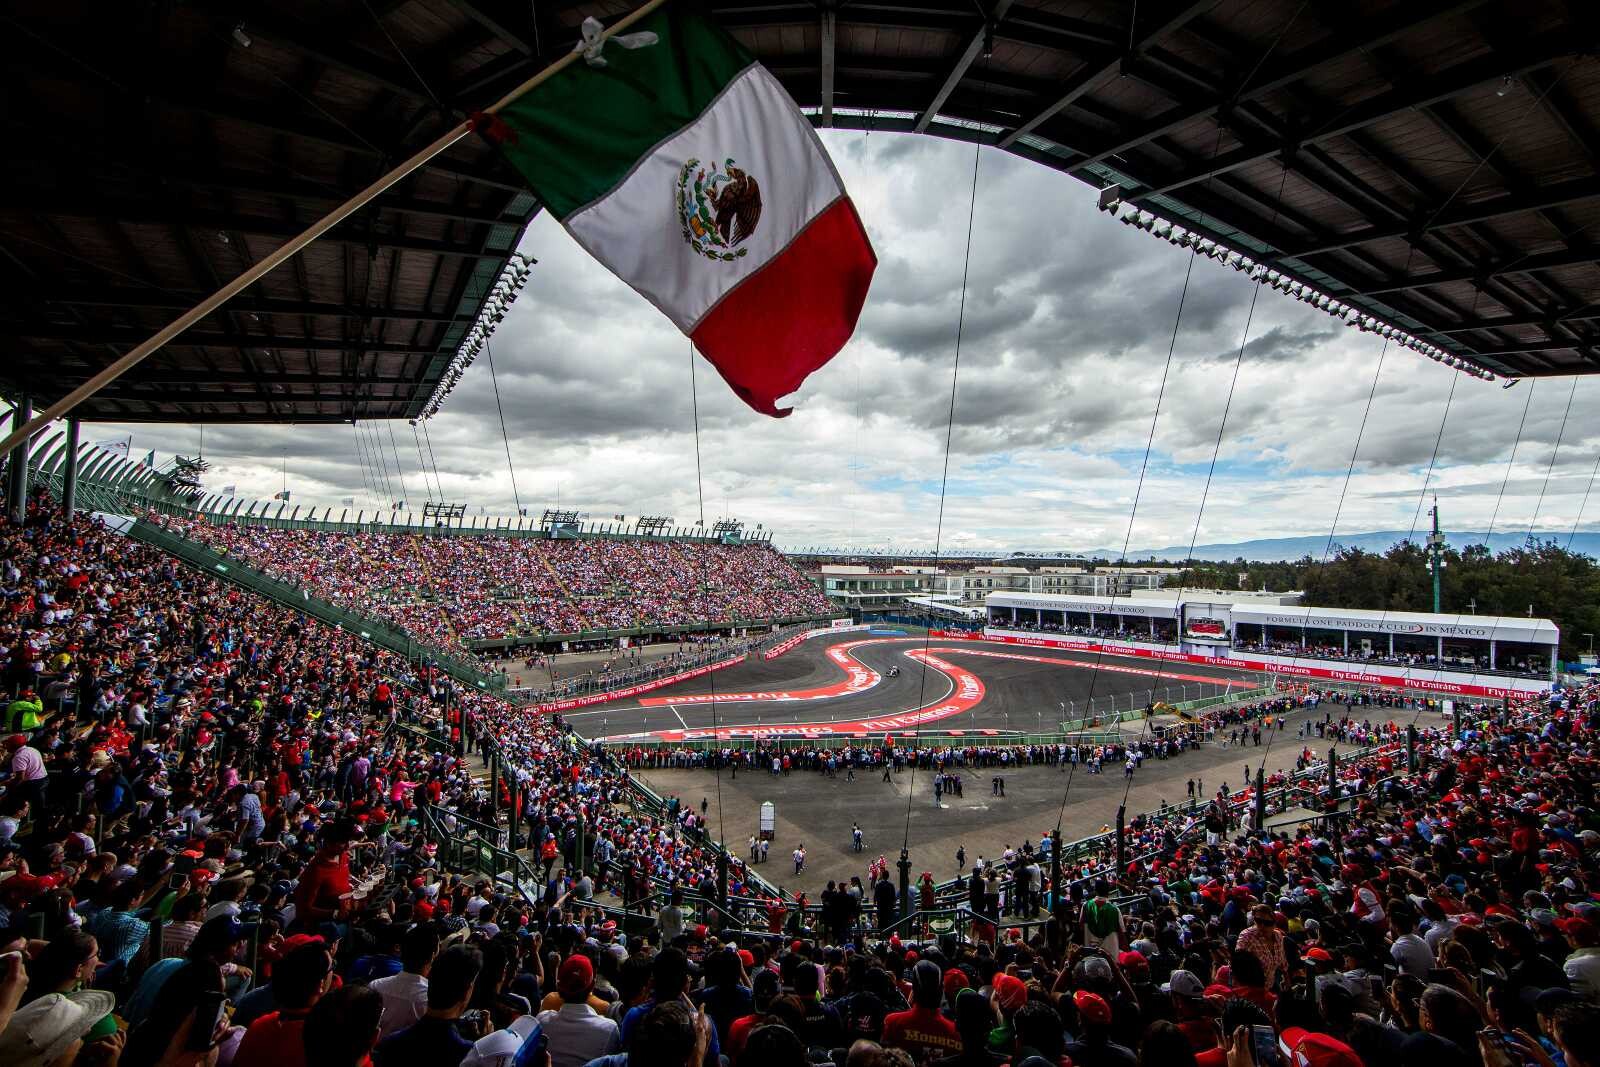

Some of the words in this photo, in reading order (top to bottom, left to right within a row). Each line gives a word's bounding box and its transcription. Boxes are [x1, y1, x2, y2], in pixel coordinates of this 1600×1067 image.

[1266, 616, 1311, 625] FORMULA
[1336, 621, 1385, 629] PADDOCK
[1440, 627, 1486, 635] MEXICO
[1102, 645, 1112, 653] Fly
[1111, 646, 1136, 654] Emirates
[1151, 650, 1161, 658] Fly
[1204, 657, 1216, 666] Fly
[1216, 658, 1246, 667] Emirates
[1264, 663, 1277, 673] Fly
[1277, 665, 1311, 675] Emirates
[1330, 671, 1345, 680] Fly
[1345, 672, 1382, 683] Emirates
[1404, 679, 1420, 689] Fly
[1421, 680, 1462, 692] Emirates
[1488, 688, 1504, 698] Fly
[861, 720, 898, 730] Fly
[896, 705, 960, 725] Emirates
[726, 726, 833, 735] Emirates
[904, 1029, 964, 1051] Monaco
